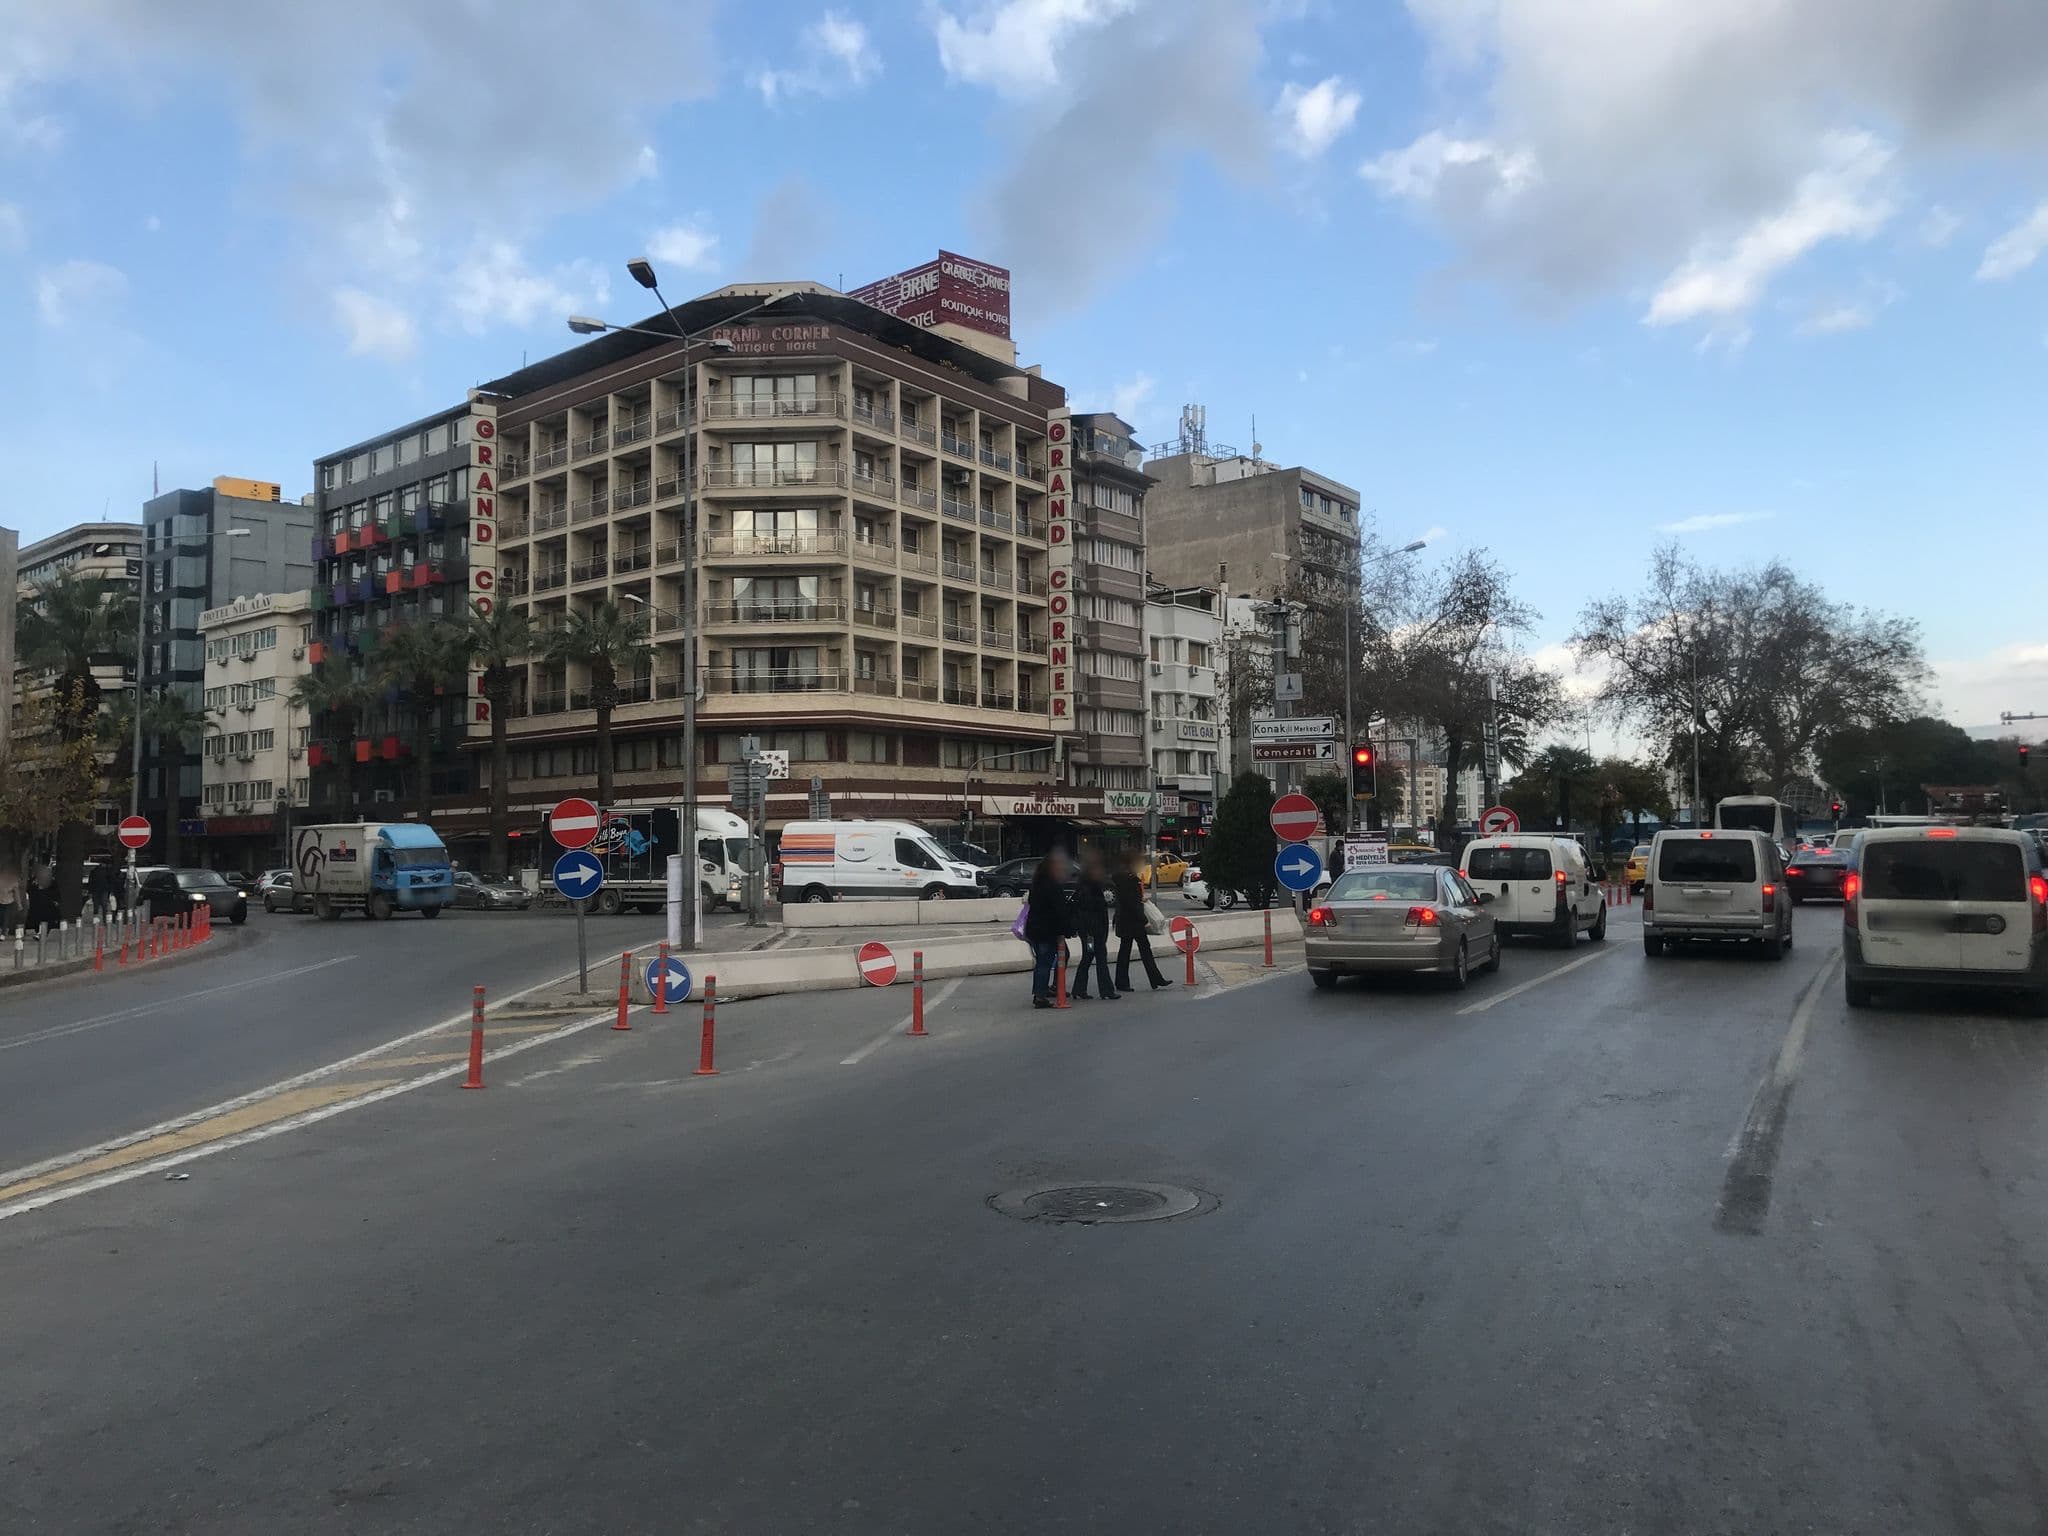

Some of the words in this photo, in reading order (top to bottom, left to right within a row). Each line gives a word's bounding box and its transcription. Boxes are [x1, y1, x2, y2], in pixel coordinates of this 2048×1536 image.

[941, 298, 984, 319] BOUTIQUE
[903, 309, 937, 328] OTEL
[712, 327, 761, 342] GRAND
[771, 326, 831, 341] CORNER
[729, 342, 776, 353] OUTIQUE
[786, 341, 817, 352] HOTEL
[475, 418, 495, 543] GRAND
[1049, 421, 1066, 544] GRAND
[203, 607, 229, 622] HOTEL
[1049, 569, 1067, 718] CORNER
[1182, 724, 1199, 737] OTEL
[1200, 726, 1215, 739] GAR
[1254, 723, 1286, 734] Konak
[1255, 747, 1316, 758] Kemeraltı
[1110, 792, 1145, 807] YÖRÜK
[1013, 802, 1042, 814] GRAND
[1045, 802, 1076, 815] CORNER
